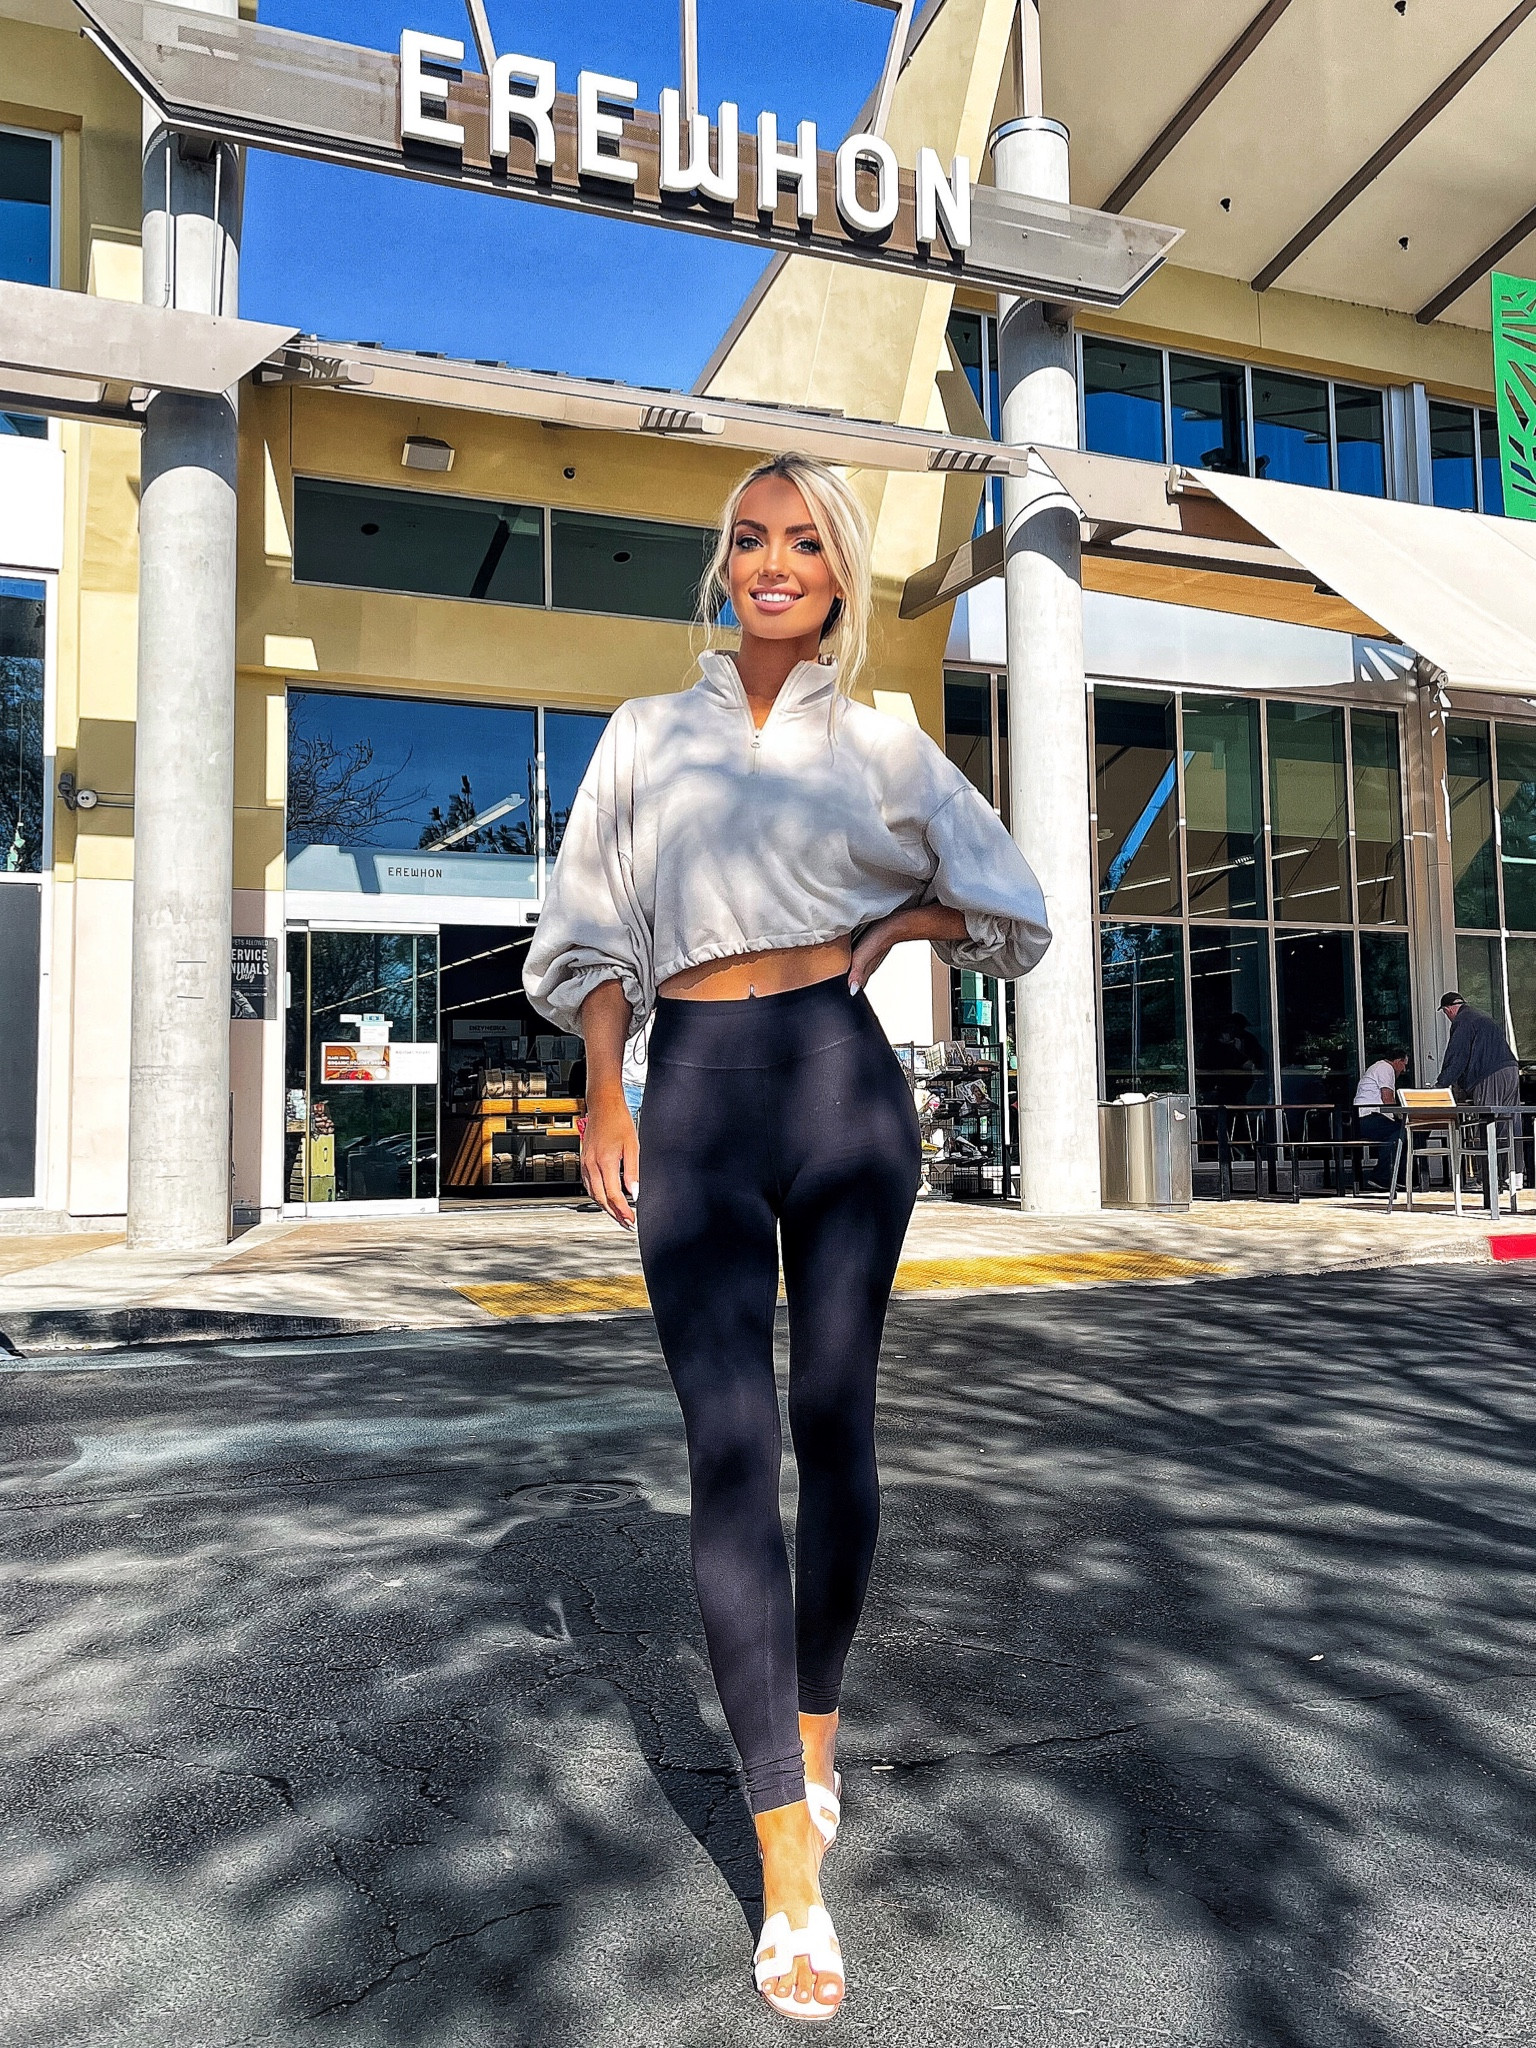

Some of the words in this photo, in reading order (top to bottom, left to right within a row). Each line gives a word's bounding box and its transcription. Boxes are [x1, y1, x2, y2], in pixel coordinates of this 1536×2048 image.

[400, 29, 971, 251] EREWHON
[388, 866, 442, 878] EREWHON
[231, 948, 268, 961] ERVICE
[231, 962, 269, 976] NIMALS
[236, 971, 255, 983] Only
